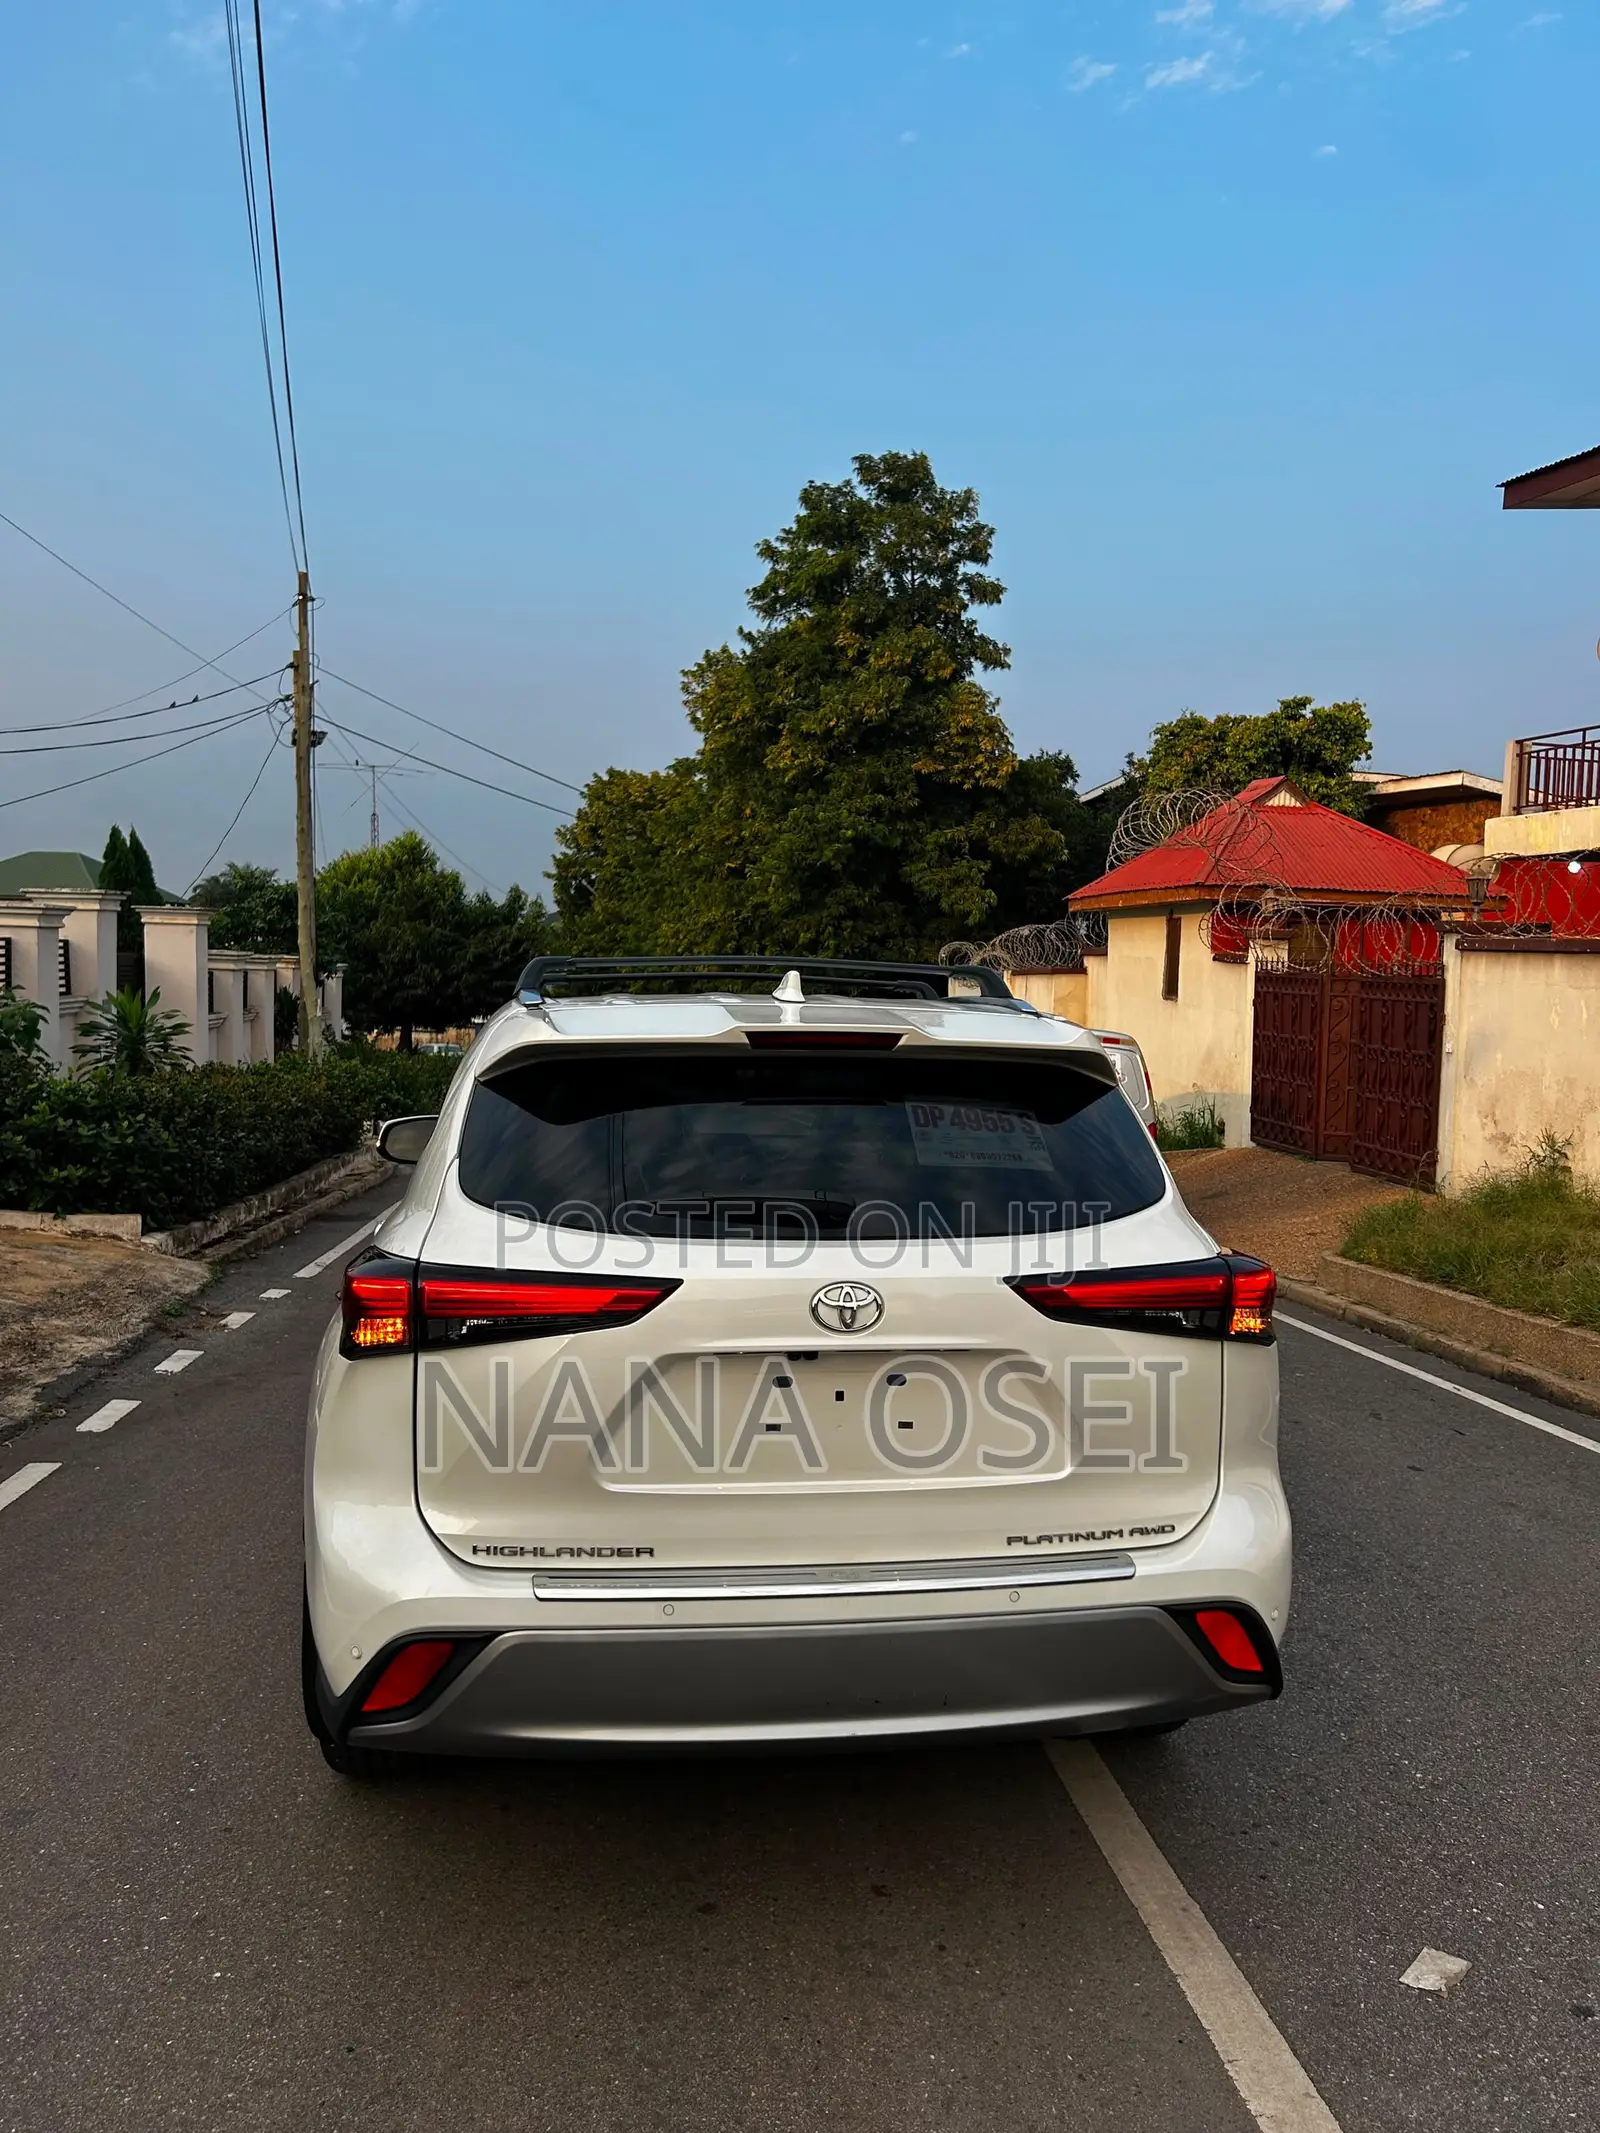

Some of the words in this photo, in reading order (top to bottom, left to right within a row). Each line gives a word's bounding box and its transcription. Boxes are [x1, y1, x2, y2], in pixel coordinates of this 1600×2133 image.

[910, 1105, 945, 1128] DP
[950, 1106, 1016, 1133] 4955
[1006, 1528, 1123, 1546] PLATINUM
[1129, 1524, 1175, 1537] AWD
[472, 1544, 655, 1557] HIGHLANDER
